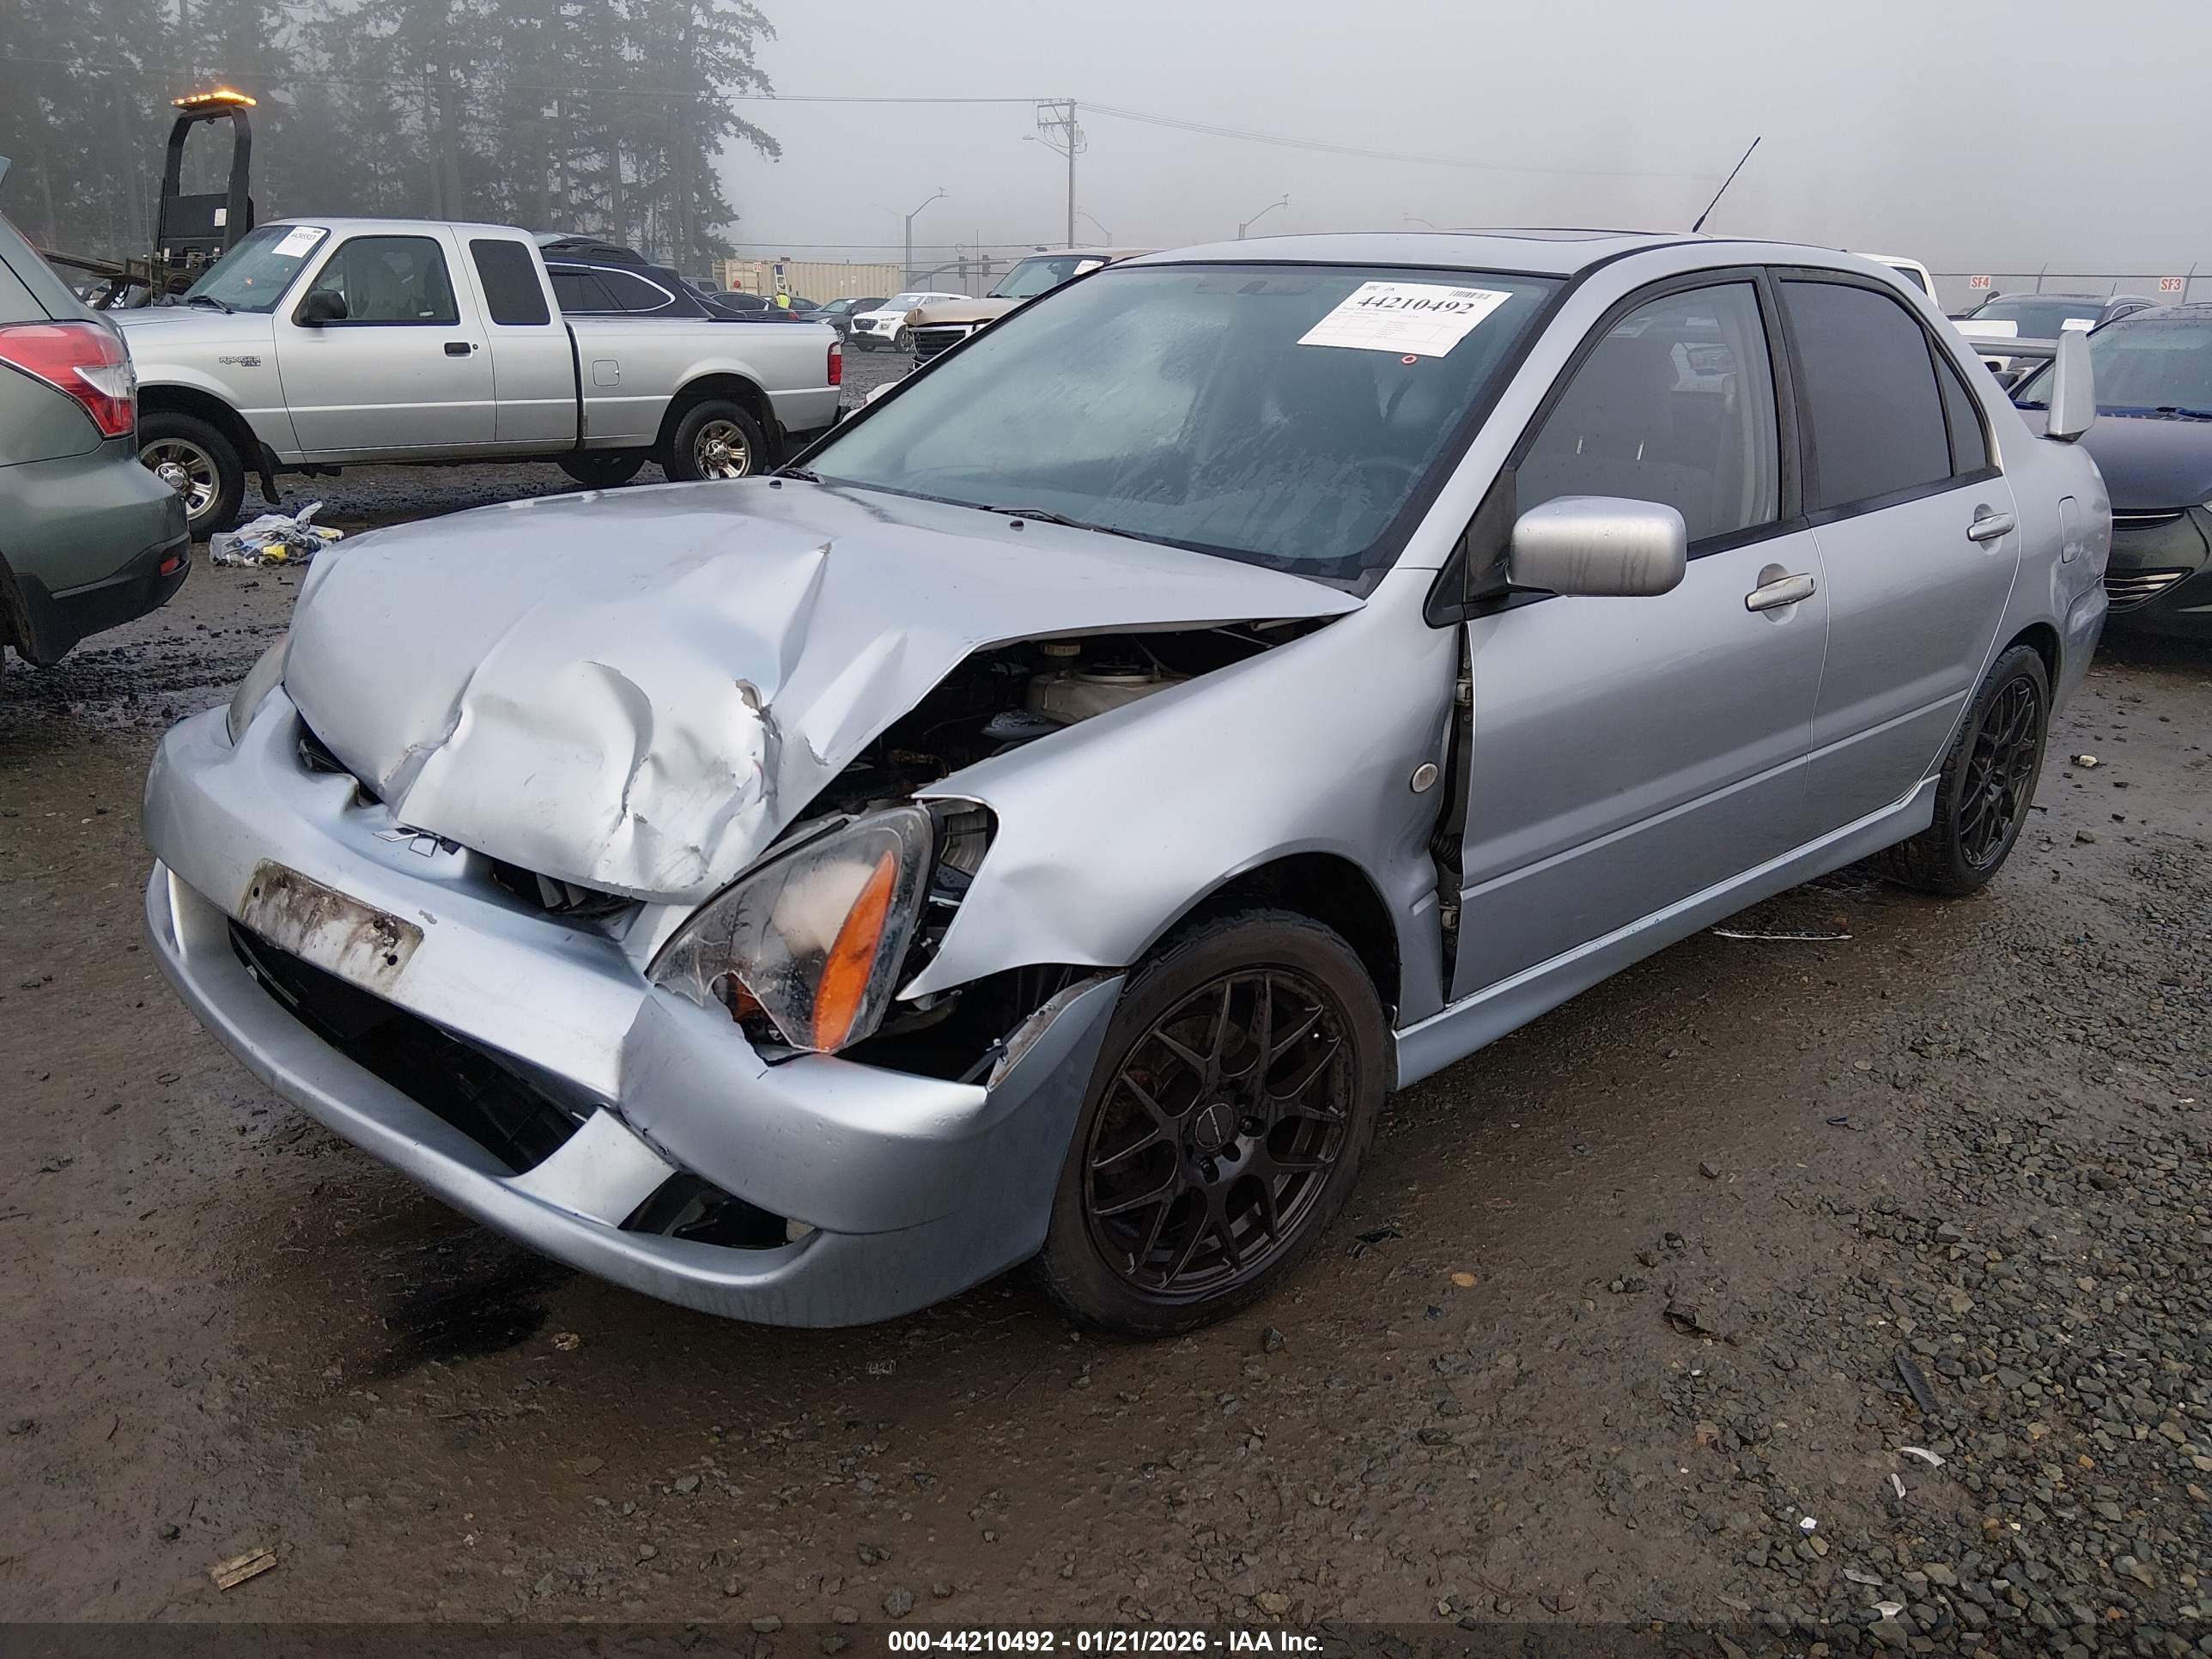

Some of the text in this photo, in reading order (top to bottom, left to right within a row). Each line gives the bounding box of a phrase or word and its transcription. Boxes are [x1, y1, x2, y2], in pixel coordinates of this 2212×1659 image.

[1971, 276, 1990, 289] SF4
[2160, 278, 2182, 290] SF3
[1357, 295, 1475, 315] 44210492
